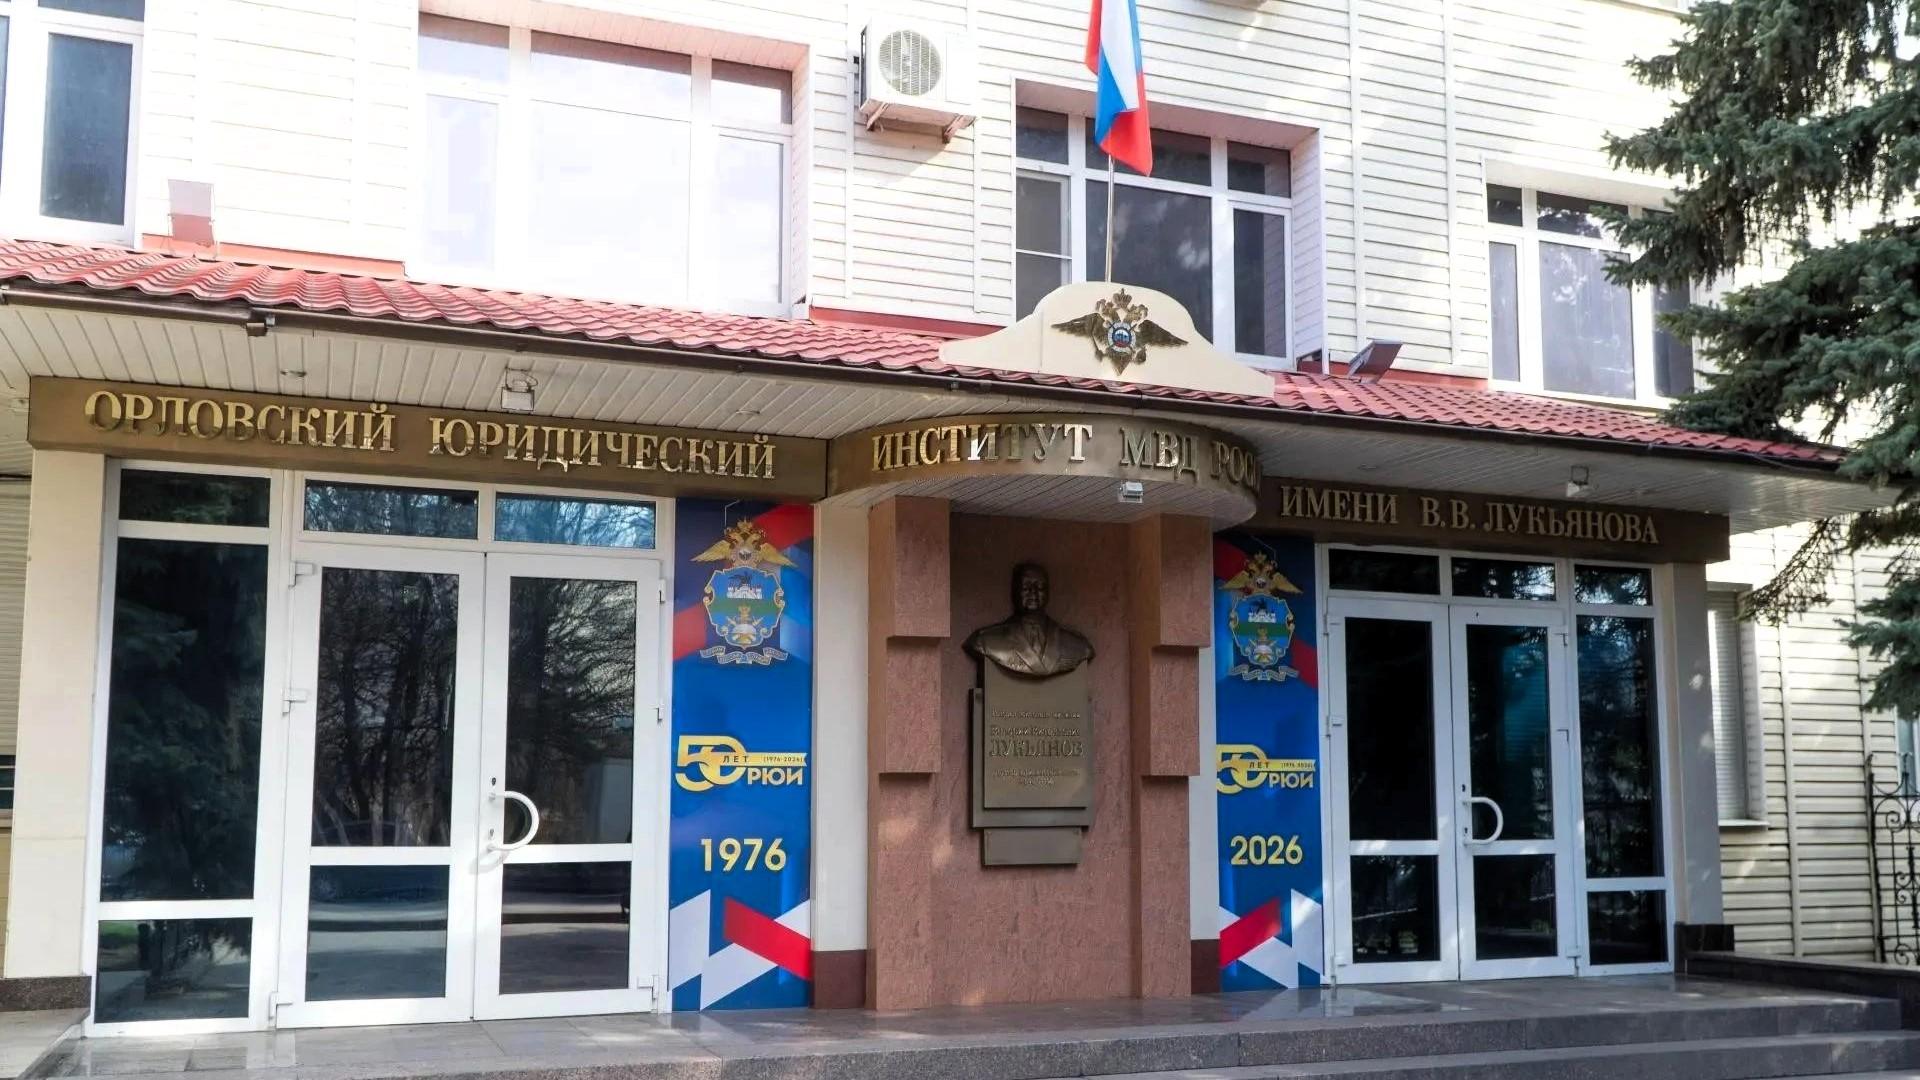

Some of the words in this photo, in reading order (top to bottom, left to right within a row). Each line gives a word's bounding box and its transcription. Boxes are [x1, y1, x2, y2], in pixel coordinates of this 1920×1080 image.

[84, 390, 396, 451] ОРЛОВСКИЙ
[428, 417, 775, 479] ЮРИДИЧЕСКИЙ
[871, 423, 1093, 471] ИНСТИТУТ
[1120, 426, 1199, 482] МВД
[1280, 485, 1398, 524] ИМЕНИ
[1483, 502, 1659, 544] ЛУКЬЯНОВА
[675, 735, 747, 792] 50
[722, 755, 750, 763] ЛЕТ
[1249, 761, 1270, 769] ЛЕТ
[701, 837, 787, 871] 1976
[1230, 835, 1303, 865] 2026
